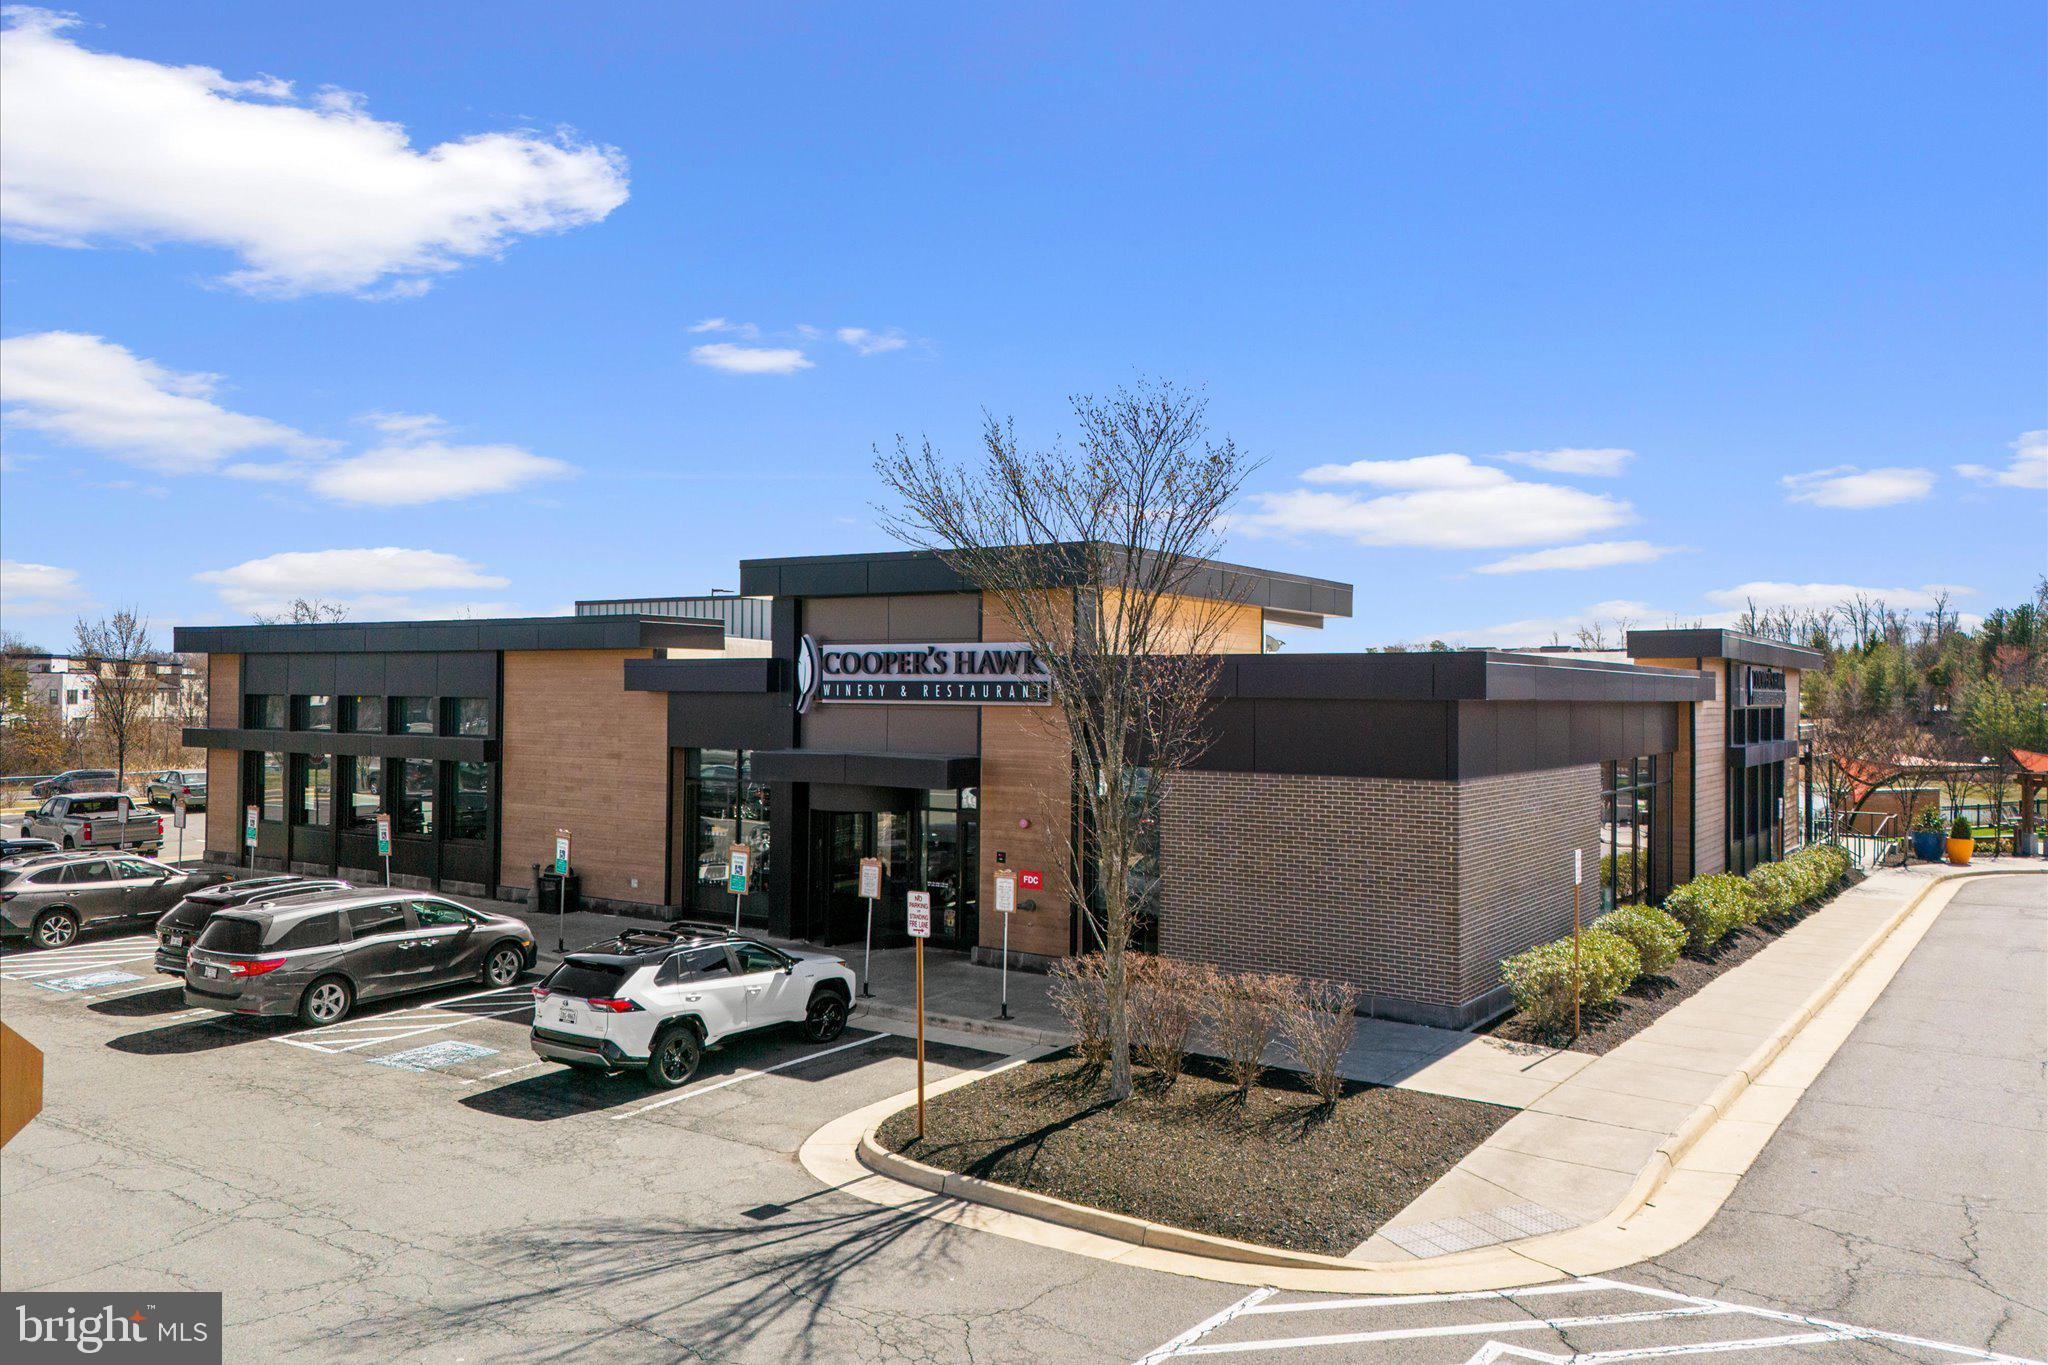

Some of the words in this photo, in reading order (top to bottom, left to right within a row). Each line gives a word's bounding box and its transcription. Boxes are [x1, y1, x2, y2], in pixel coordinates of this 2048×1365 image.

[822, 646, 947, 675] COOPER'S
[953, 649, 1047, 675] HAWK
[823, 684, 885, 698] WINERY
[901, 685, 908, 698] &
[922, 684, 1041, 698] RESTAURANT
[1023, 875, 1039, 885] FDC
[909, 913, 928, 921] STANDING
[909, 920, 917, 928] FIRE
[918, 921, 929, 929] LANE
